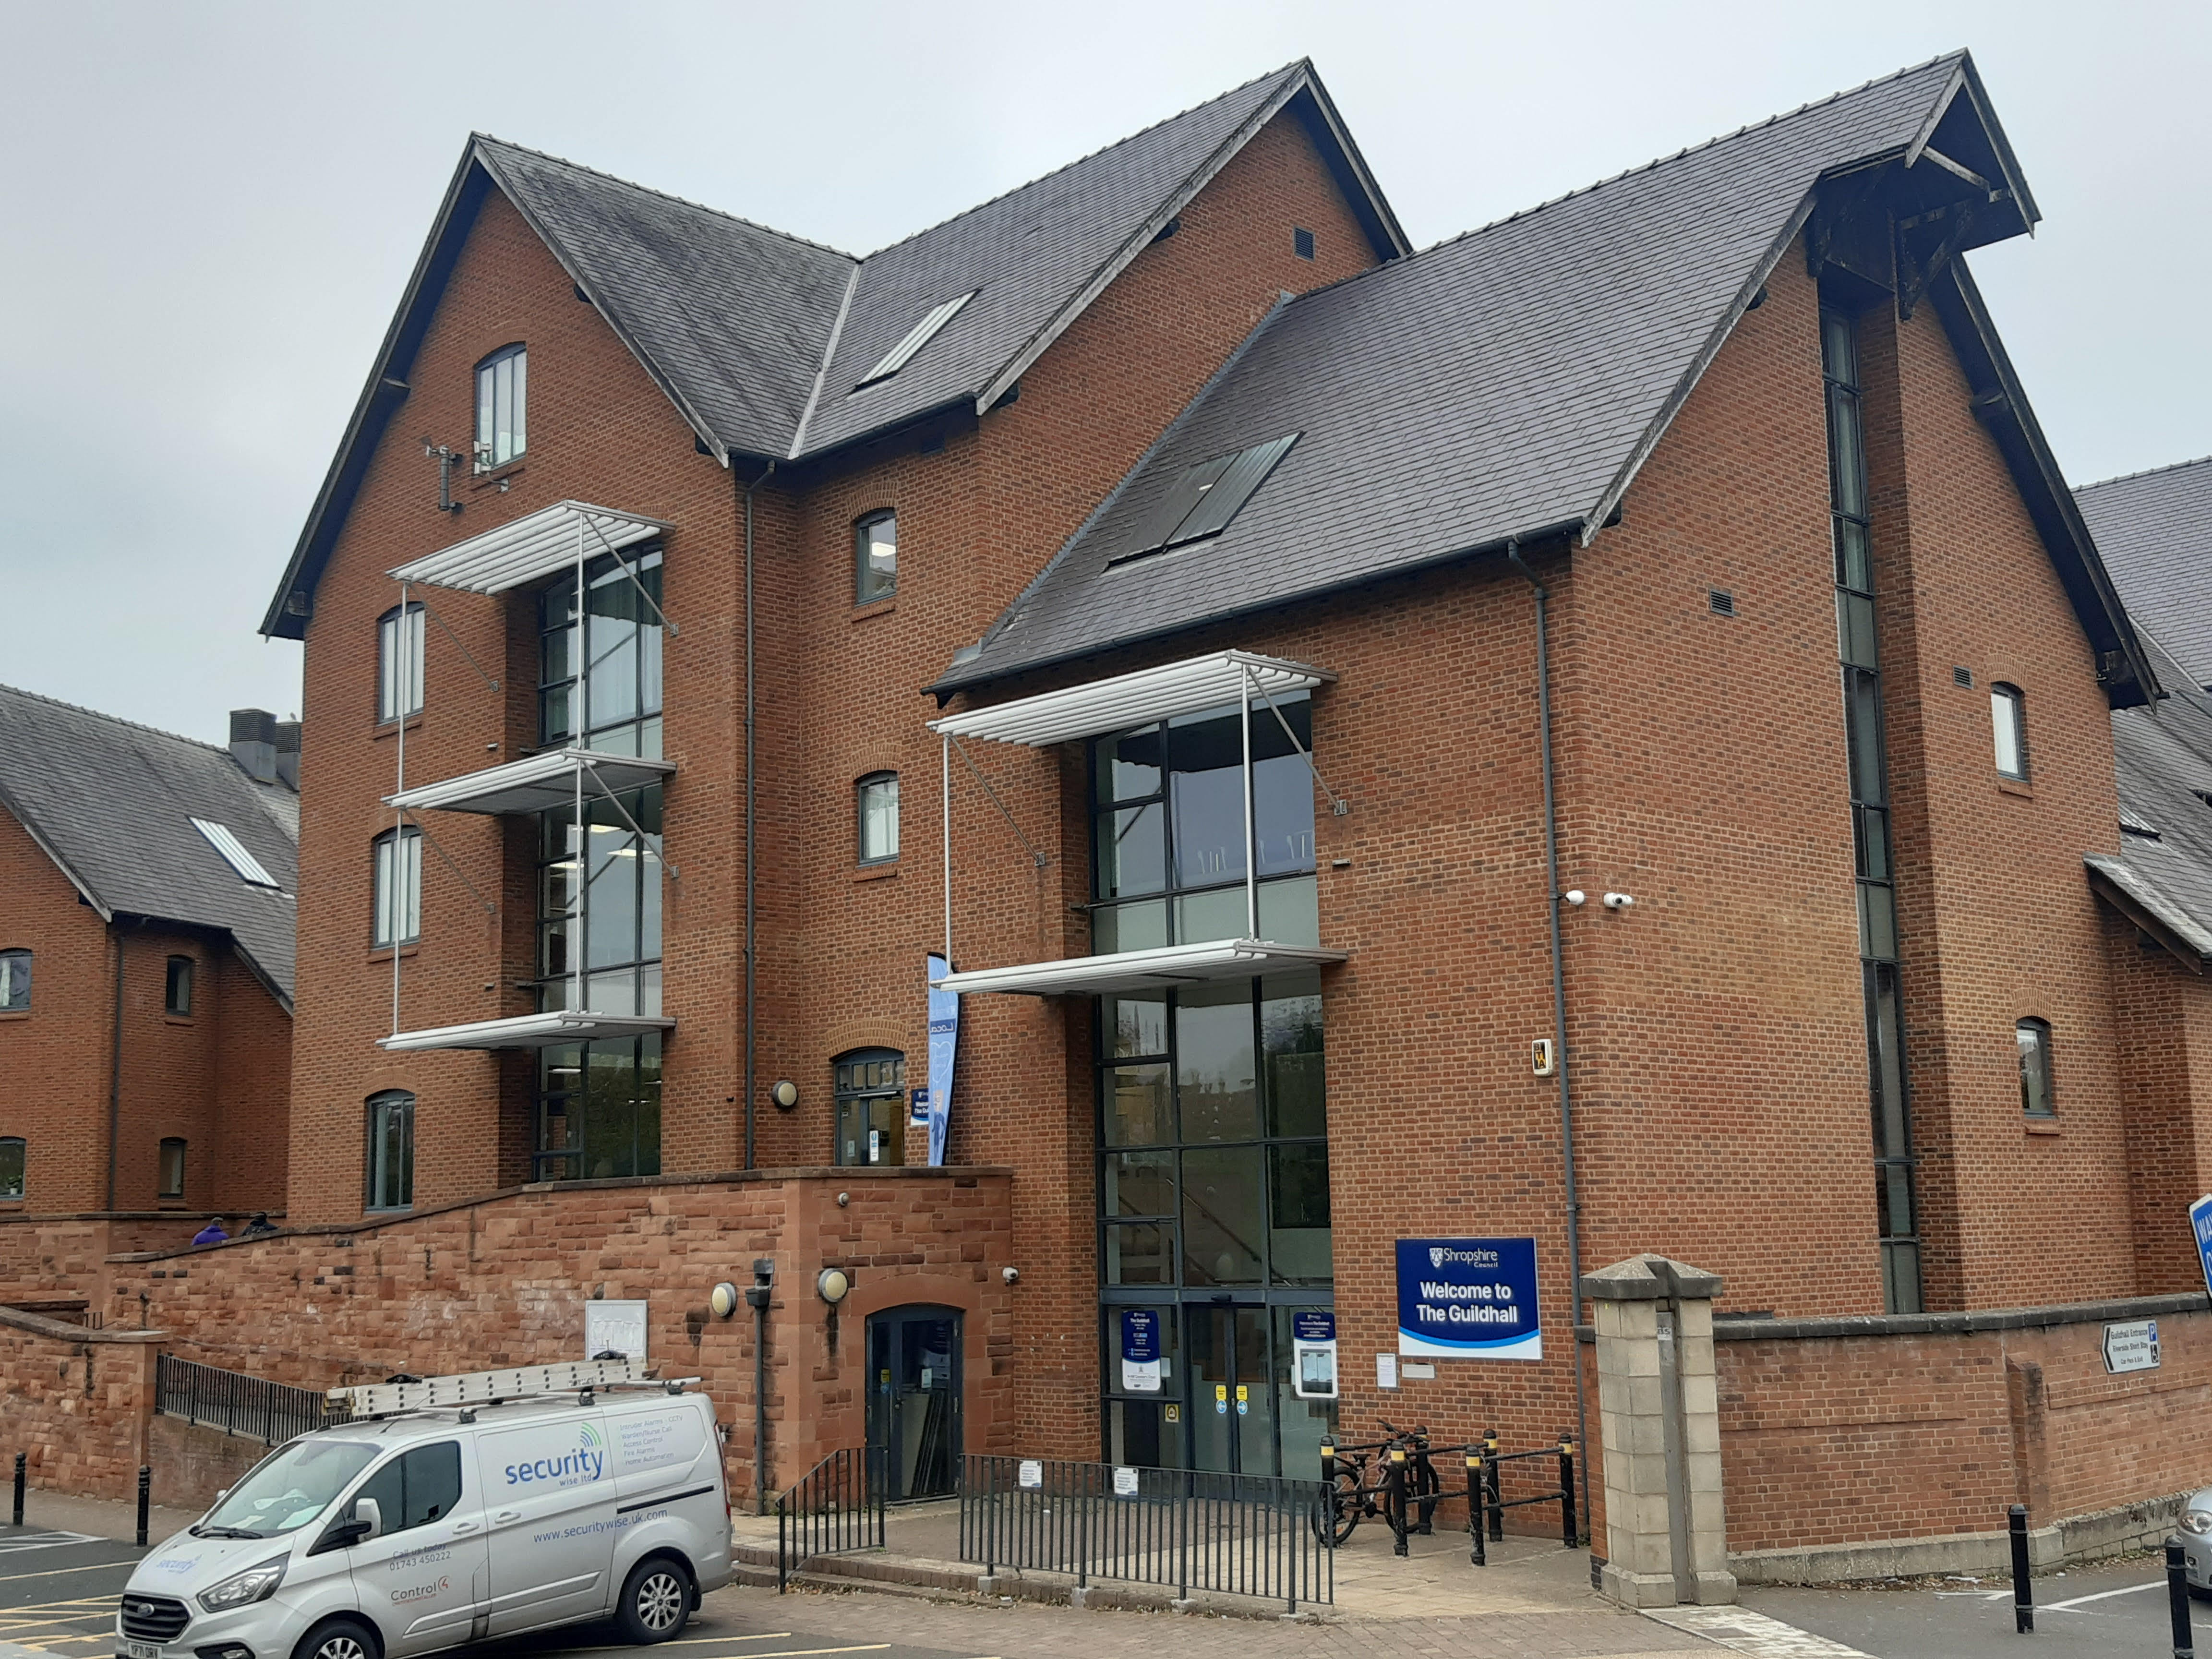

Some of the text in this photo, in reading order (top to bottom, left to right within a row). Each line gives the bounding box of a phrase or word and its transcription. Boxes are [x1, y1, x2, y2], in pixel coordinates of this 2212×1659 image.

[1443, 1248, 1498, 1264] Shropshire
[1419, 1281, 1511, 1299] Welcome to
[1416, 1304, 1517, 1322] The Guildhall
[643, 1437, 663, 1445] Control
[505, 1448, 603, 1484] security
[643, 1453, 674, 1462] Automation
[559, 1473, 592, 1486] wise ltd
[533, 1509, 668, 1543] www.securitywise.uk.com
[393, 1549, 408, 1559] Call
[424, 1543, 447, 1553] today
[389, 1551, 451, 1571] 01743 450222
